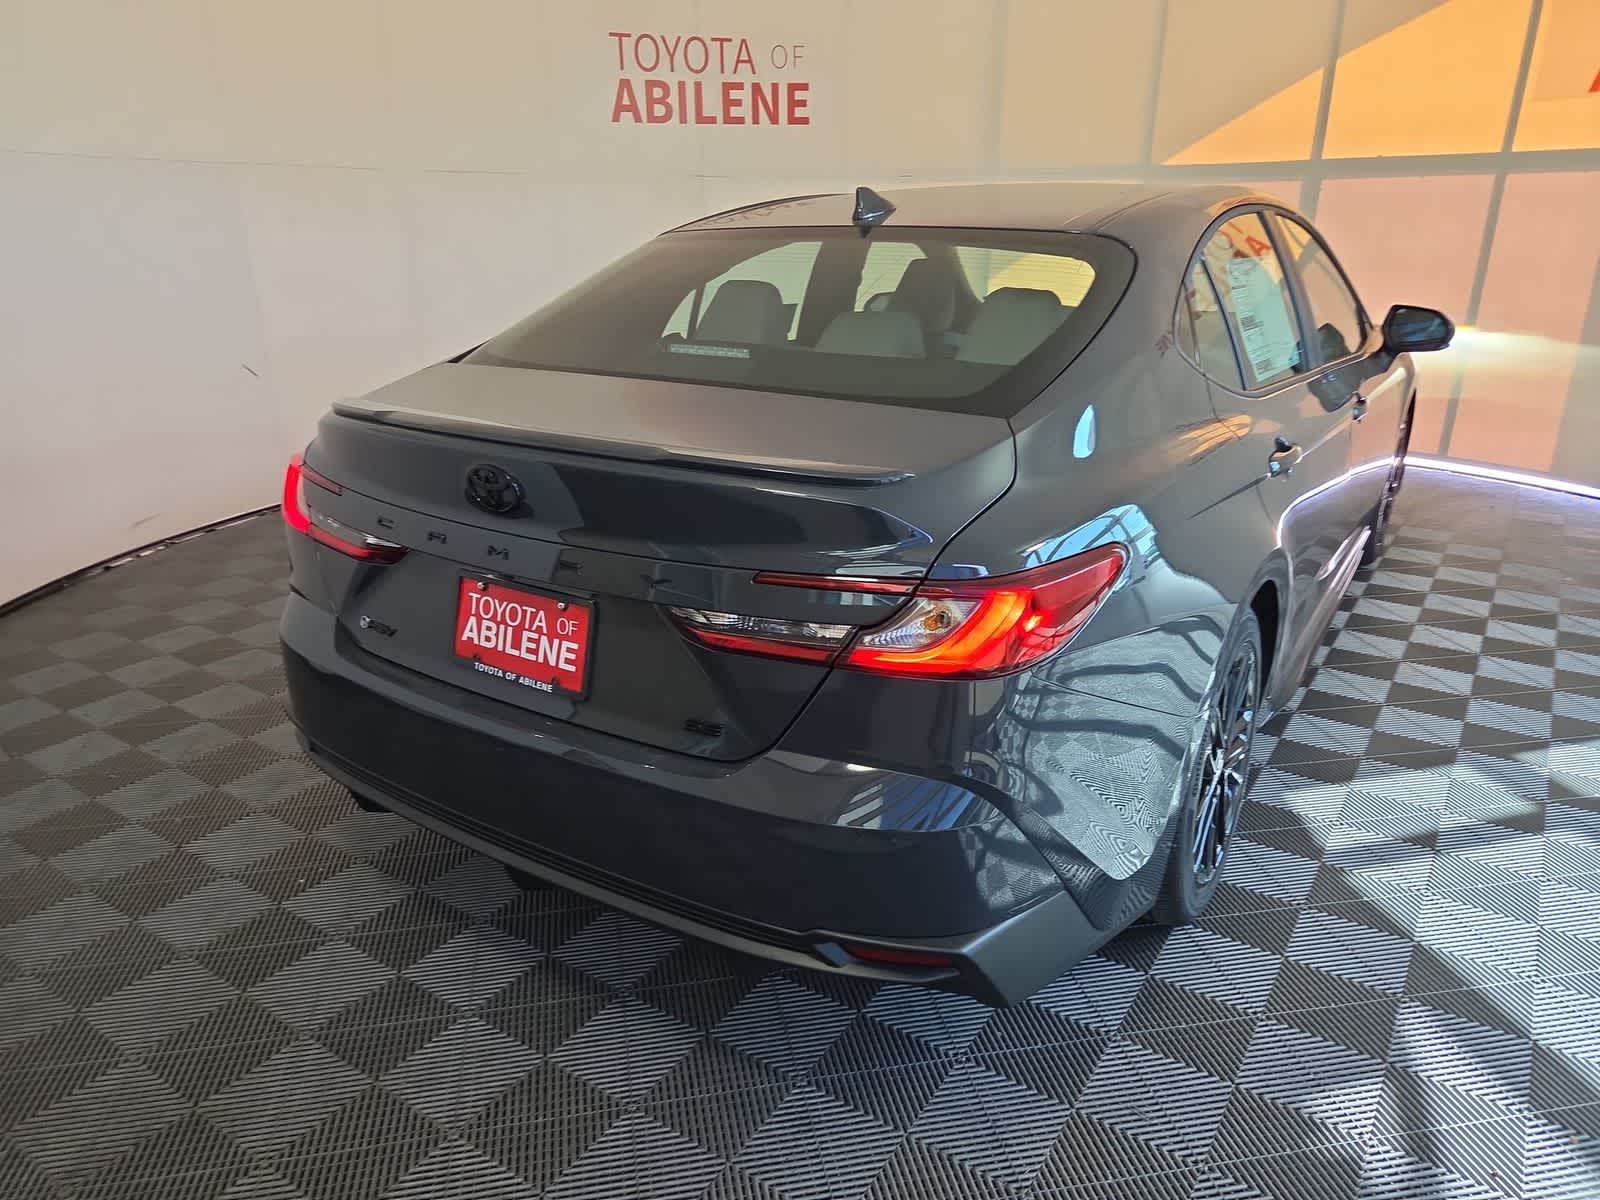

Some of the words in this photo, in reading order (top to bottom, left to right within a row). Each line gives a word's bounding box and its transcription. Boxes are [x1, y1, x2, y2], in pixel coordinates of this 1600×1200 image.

[608, 32, 756, 75] TOYOTA
[770, 44, 805, 69] OF
[611, 78, 810, 125] ABILENE
[468, 592, 548, 634] TOYOTA
[556, 617, 580, 636] OF
[461, 615, 579, 672] ABILENE
[474, 662, 503, 678] TOYOTA
[505, 672, 517, 681] OF
[519, 676, 553, 693] ABILENE
